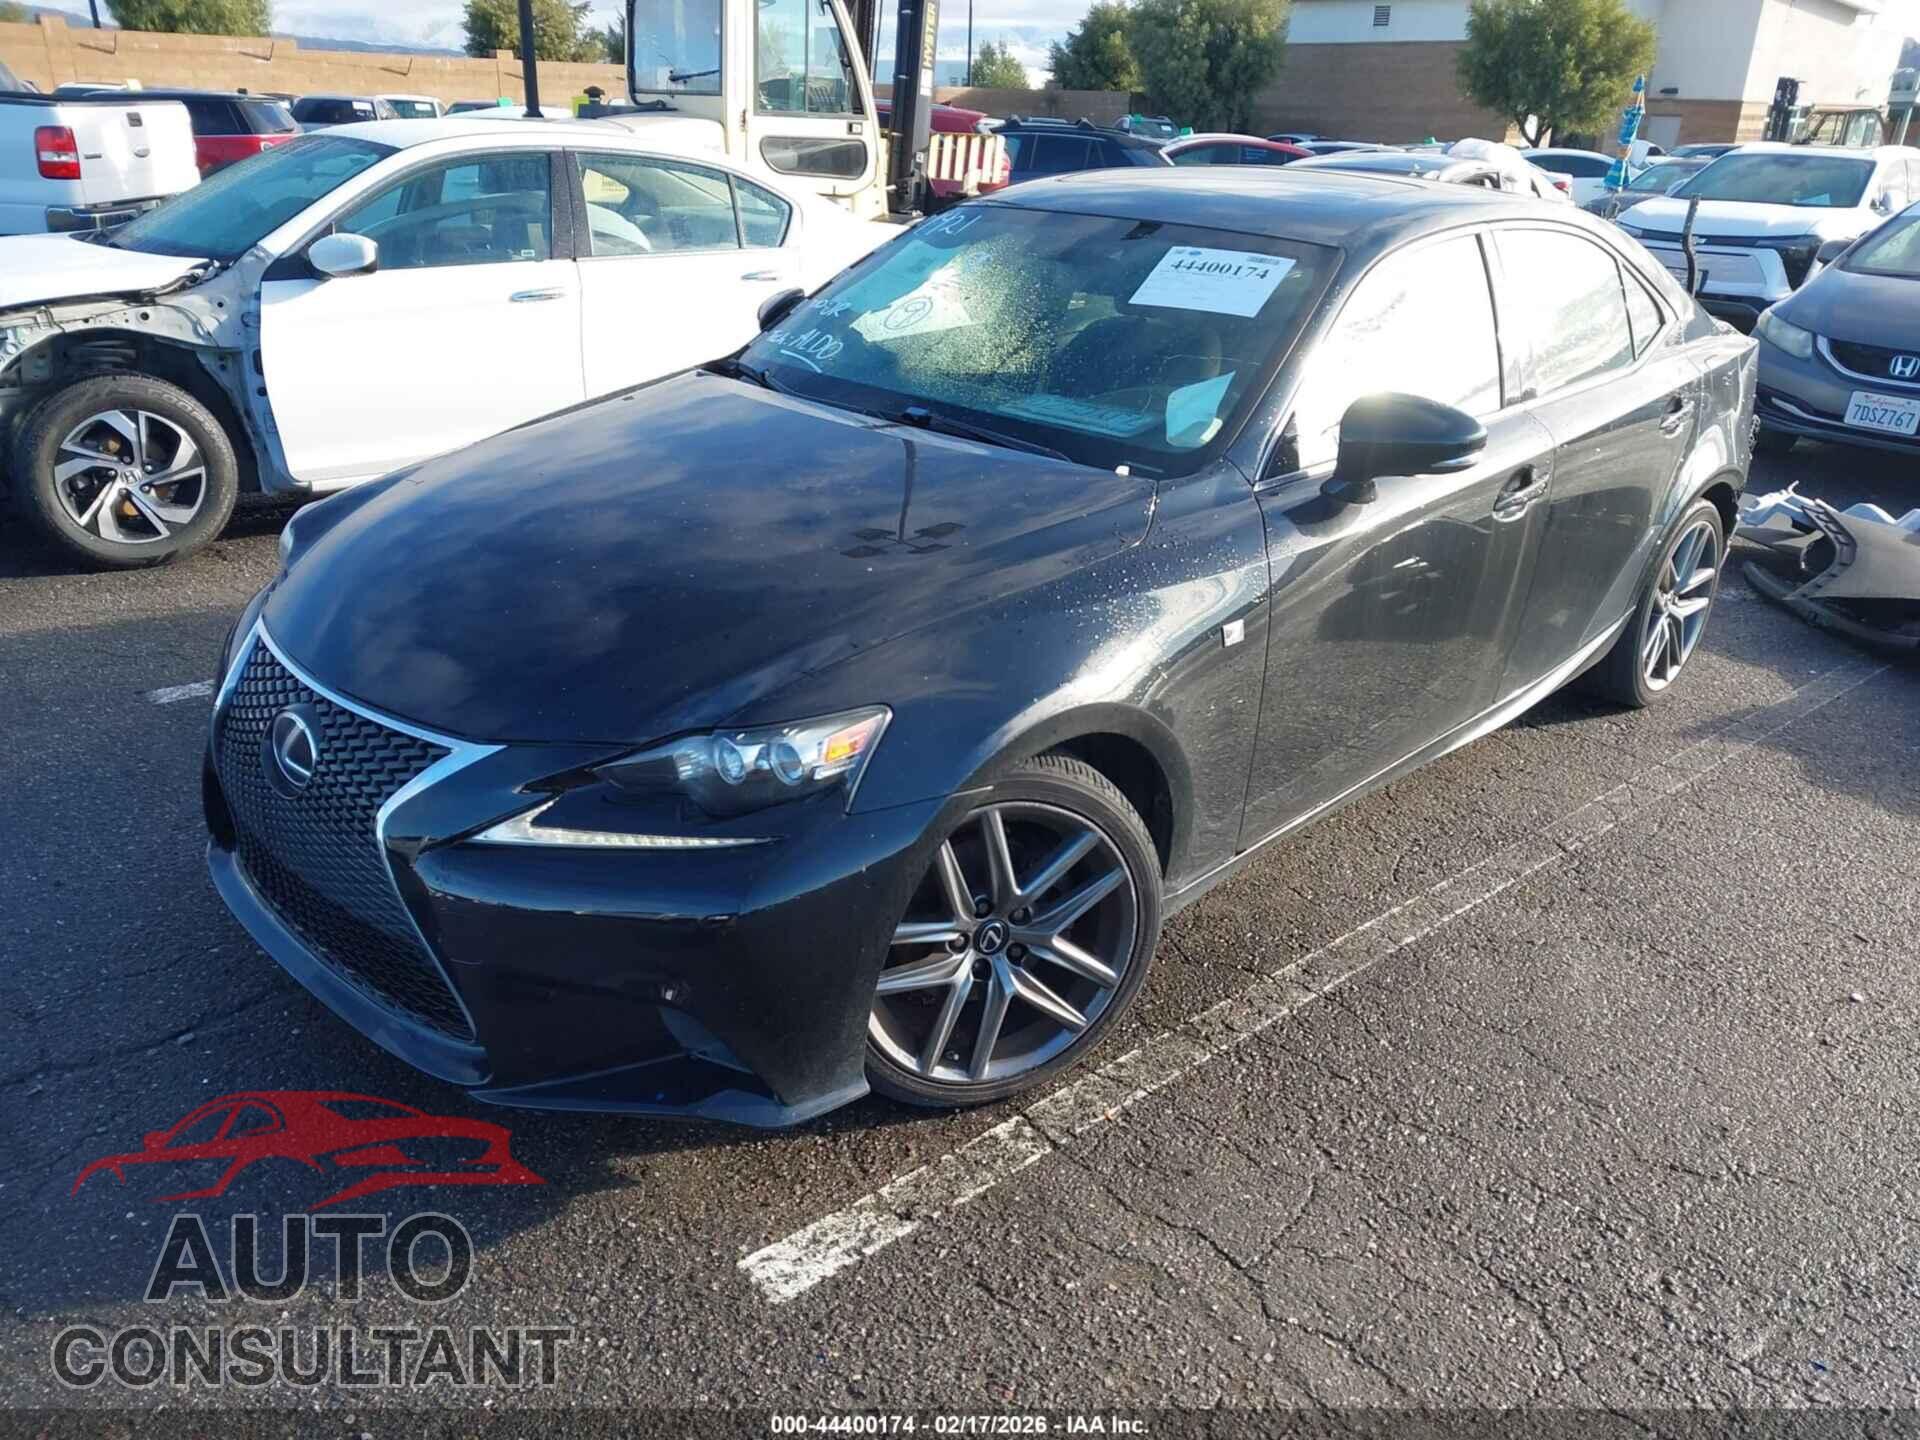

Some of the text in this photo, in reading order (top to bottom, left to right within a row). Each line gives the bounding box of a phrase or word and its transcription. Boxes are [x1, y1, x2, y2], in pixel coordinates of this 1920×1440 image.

[923, 2, 937, 68] HYSTER
[1170, 258, 1271, 280] 44400174
[1852, 404, 1916, 429] 7DSZ767
